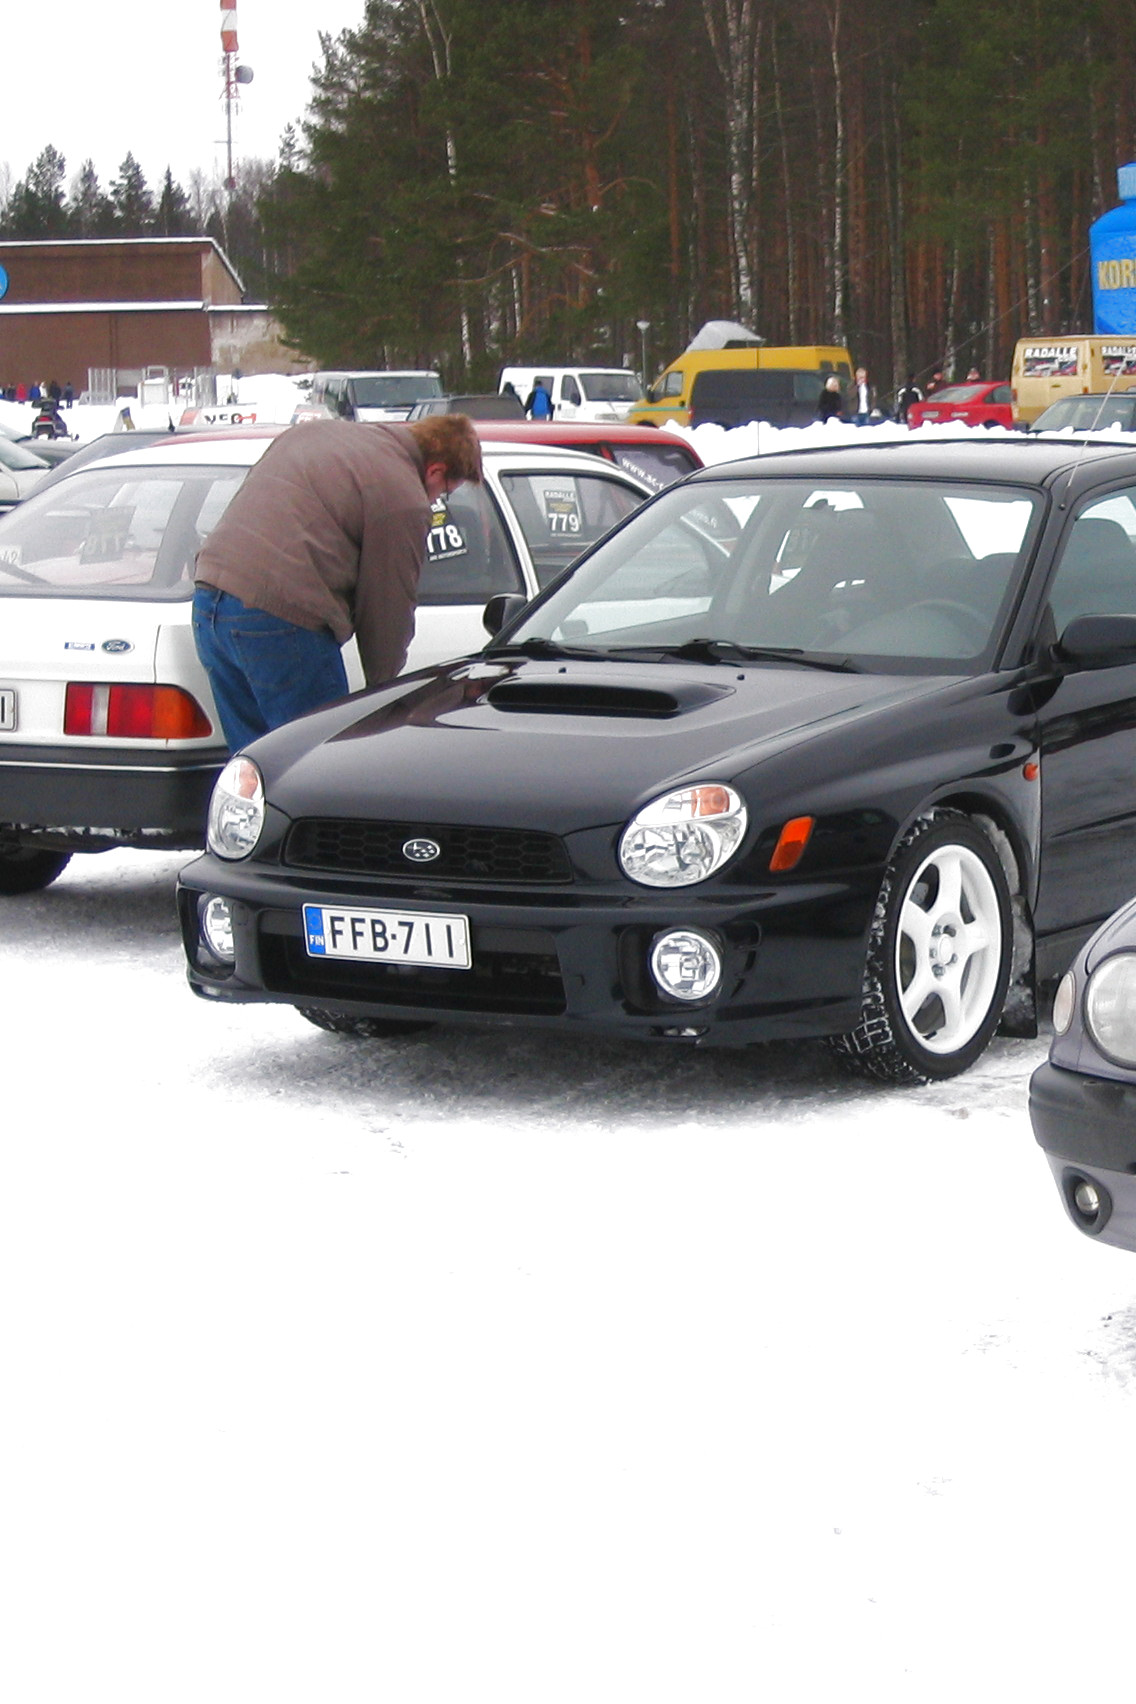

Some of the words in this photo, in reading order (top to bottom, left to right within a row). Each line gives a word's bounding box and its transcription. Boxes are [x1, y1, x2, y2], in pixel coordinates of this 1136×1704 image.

[1025, 347, 1077, 358] RADALLE
[549, 513, 580, 533] 779
[309, 934, 326, 947] FIN
